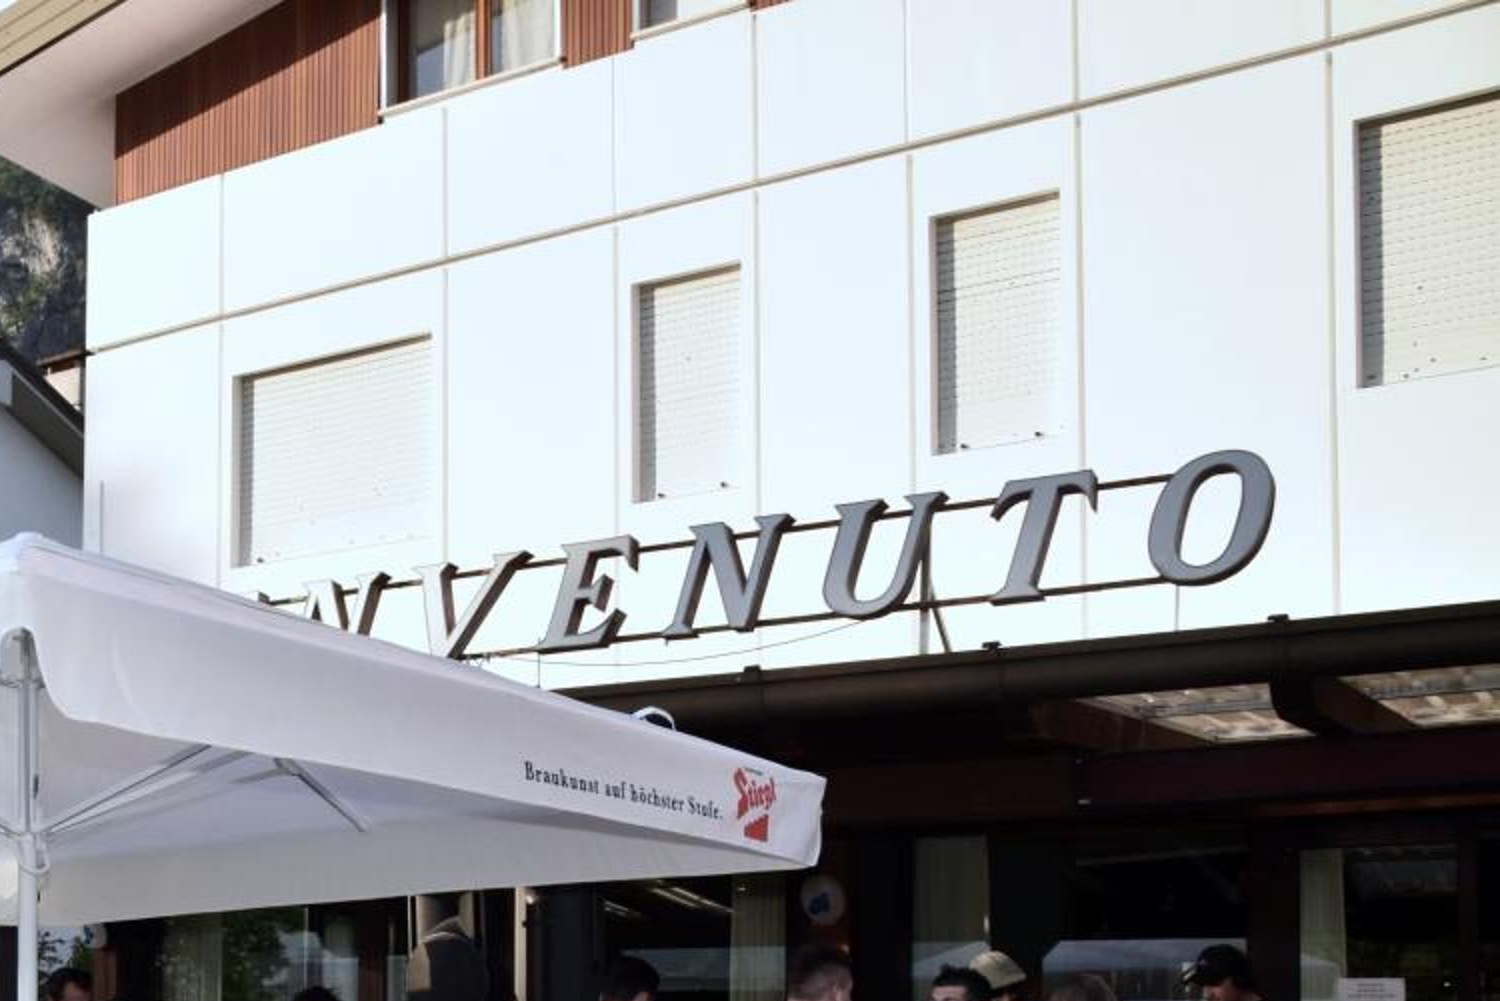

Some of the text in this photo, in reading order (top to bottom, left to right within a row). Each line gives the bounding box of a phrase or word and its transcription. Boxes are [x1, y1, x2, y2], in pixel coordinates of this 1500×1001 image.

[252, 449, 1276, 661] NVENUTO
[523, 760, 599, 795] Braukunst
[605, 780, 627, 800] auf
[629, 783, 685, 812] höchster
